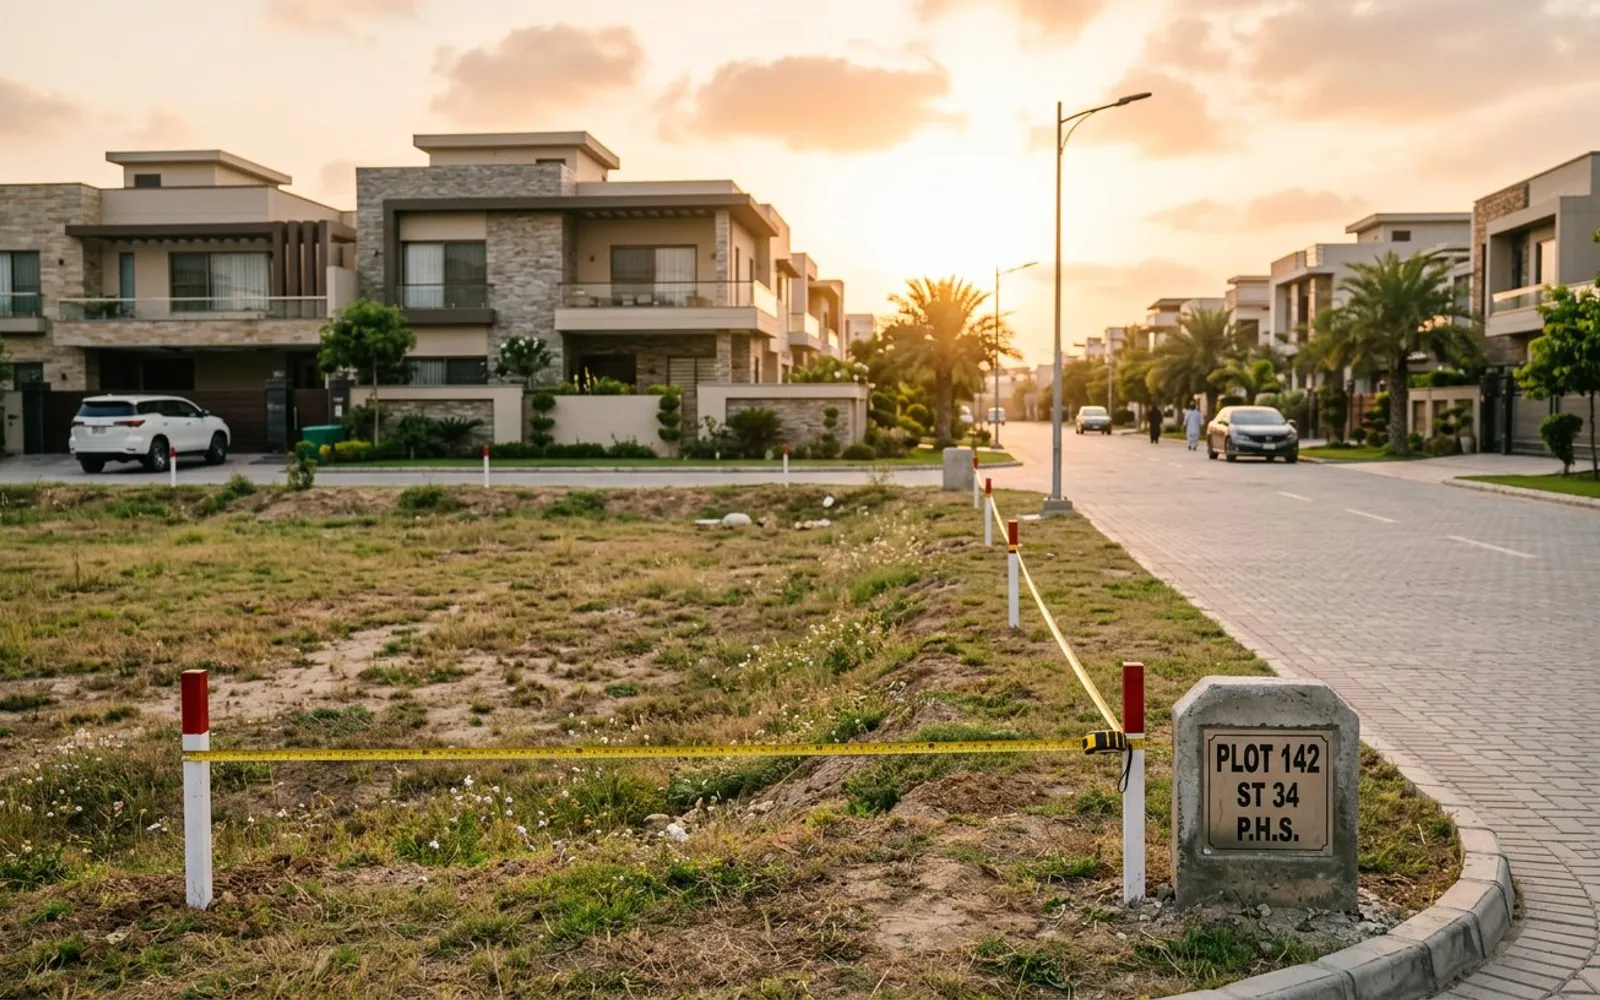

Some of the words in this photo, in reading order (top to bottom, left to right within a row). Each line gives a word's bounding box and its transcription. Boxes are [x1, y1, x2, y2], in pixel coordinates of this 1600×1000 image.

[1216, 743, 1273, 773] PLOT
[1281, 743, 1320, 773] 142
[1237, 782, 1266, 808] ST
[1272, 782, 1299, 808] 34
[1237, 816, 1299, 842] P.H.S.
